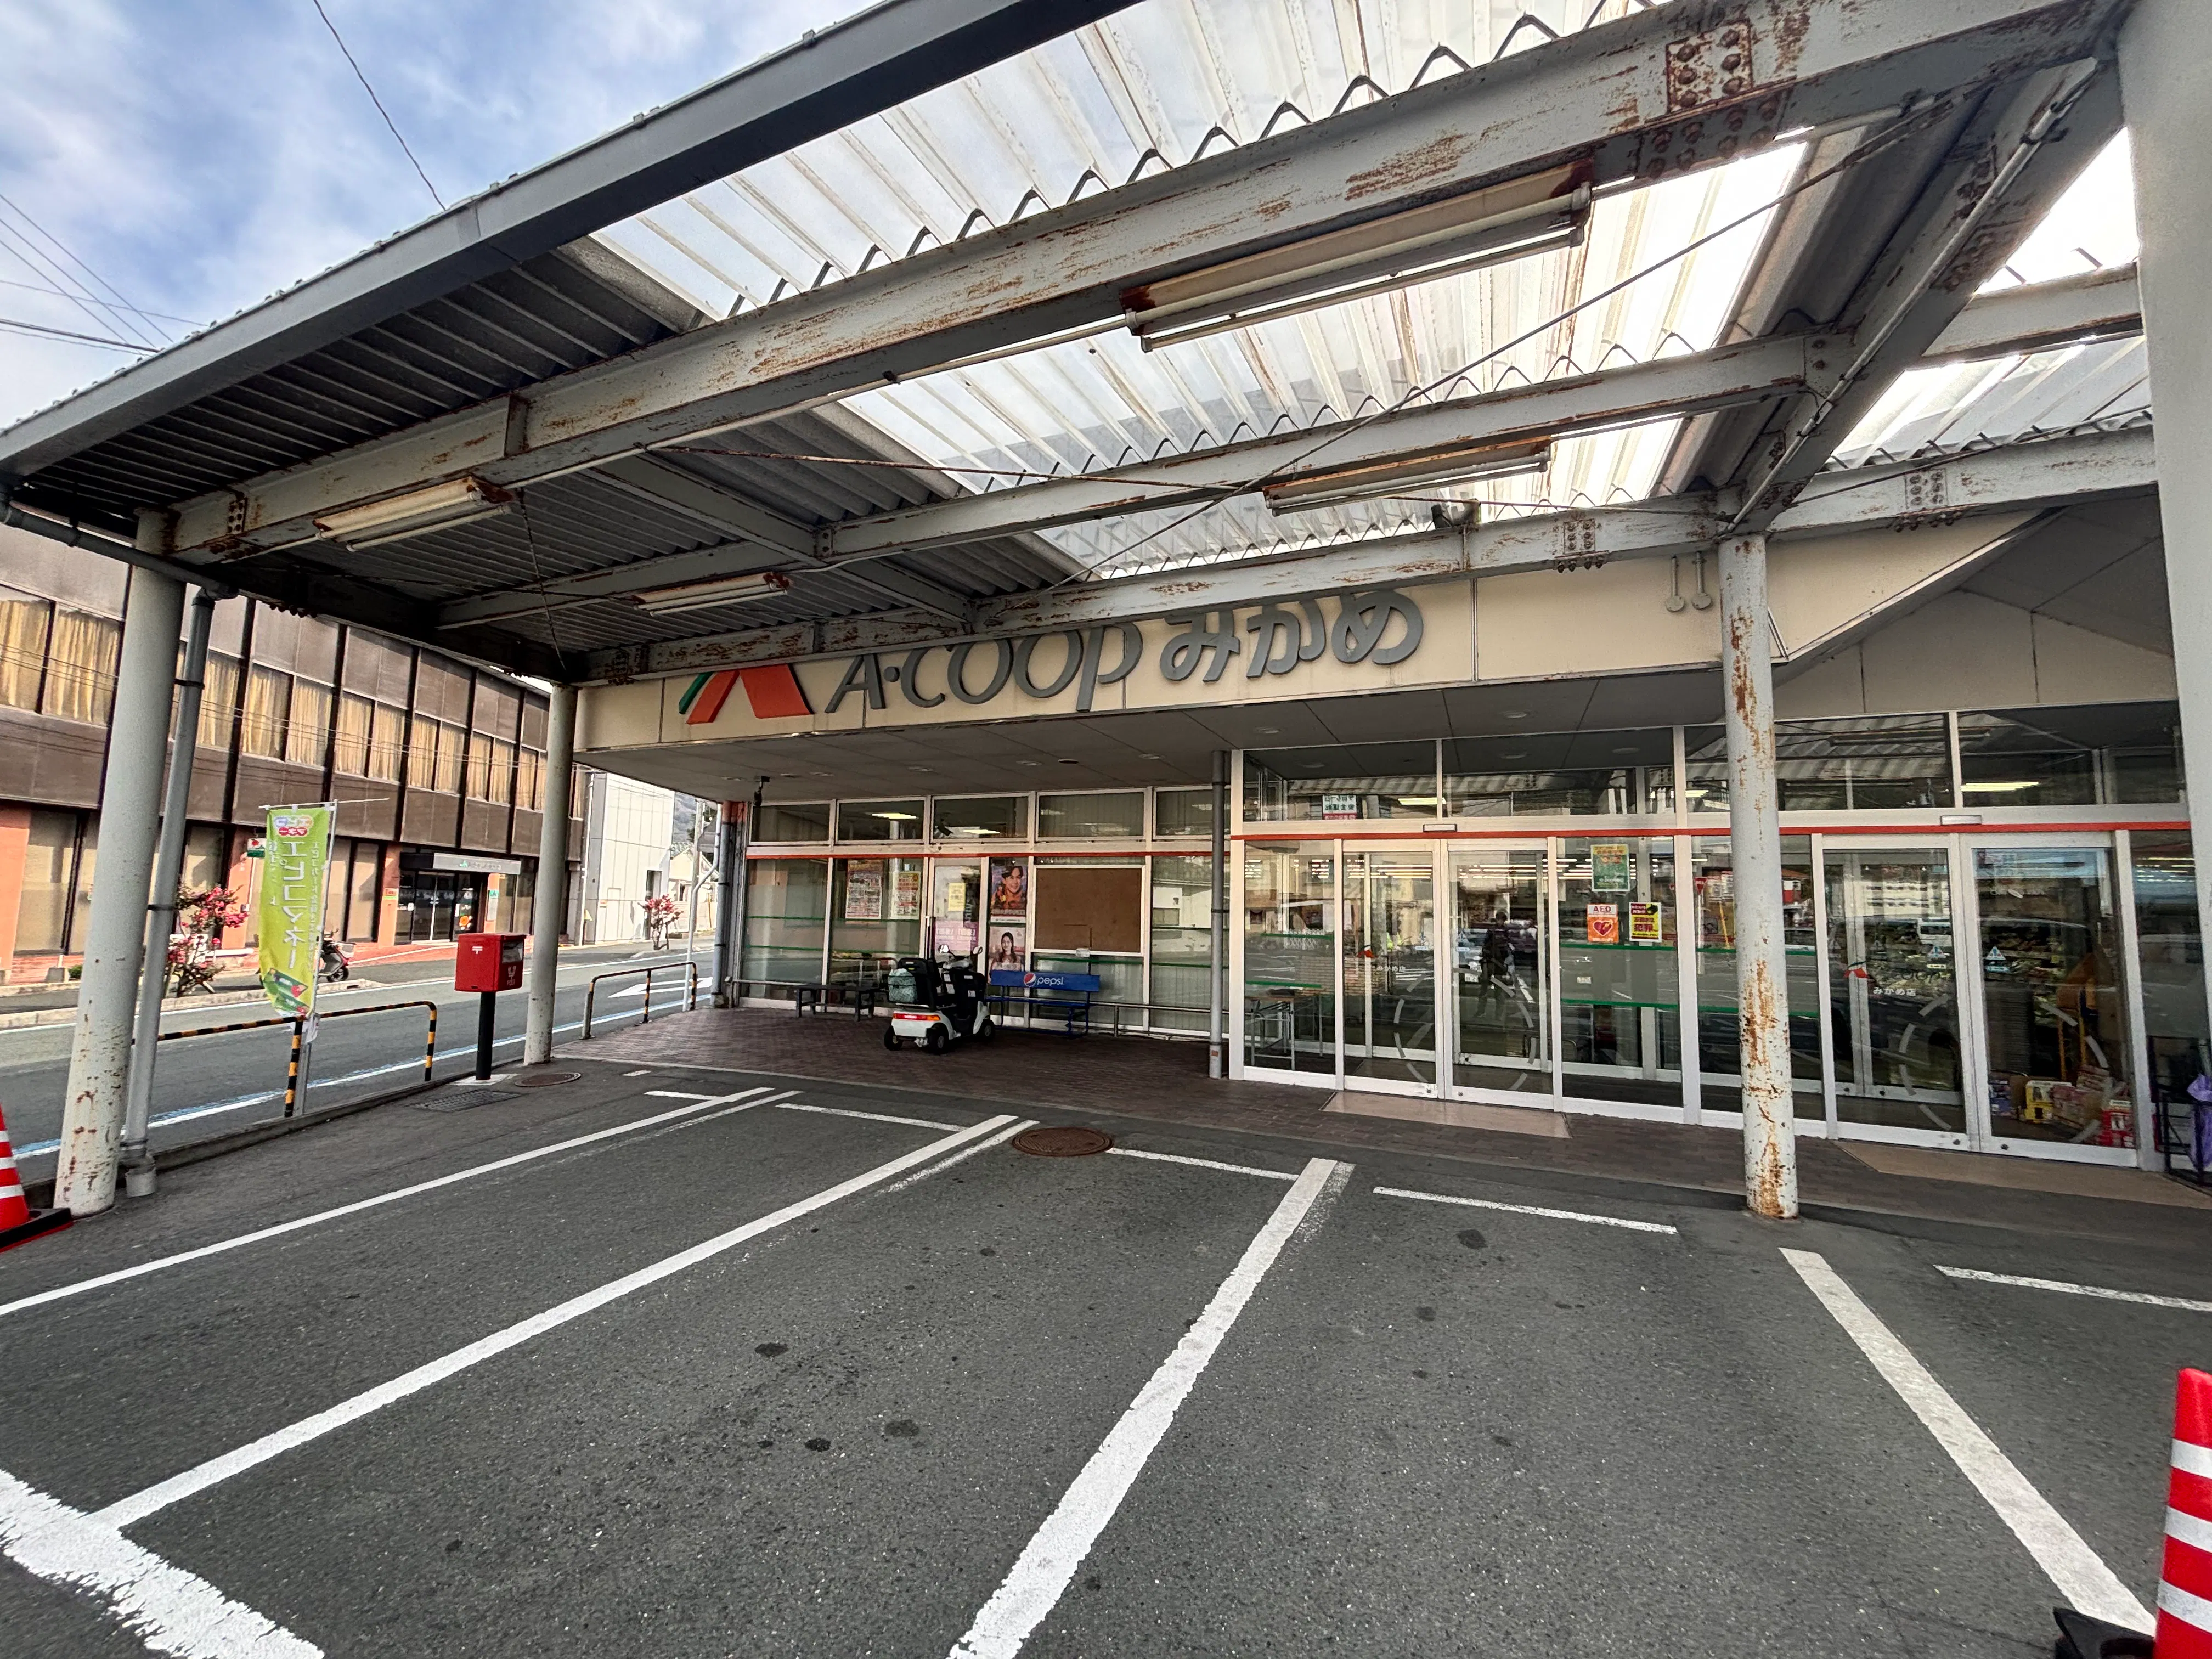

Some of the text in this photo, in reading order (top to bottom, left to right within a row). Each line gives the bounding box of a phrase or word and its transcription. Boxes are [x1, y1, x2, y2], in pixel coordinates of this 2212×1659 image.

[1159, 590, 1424, 682] みかめ
[1037, 977, 1064, 986] pepsi
[1873, 986, 1916, 996] みかめ店
